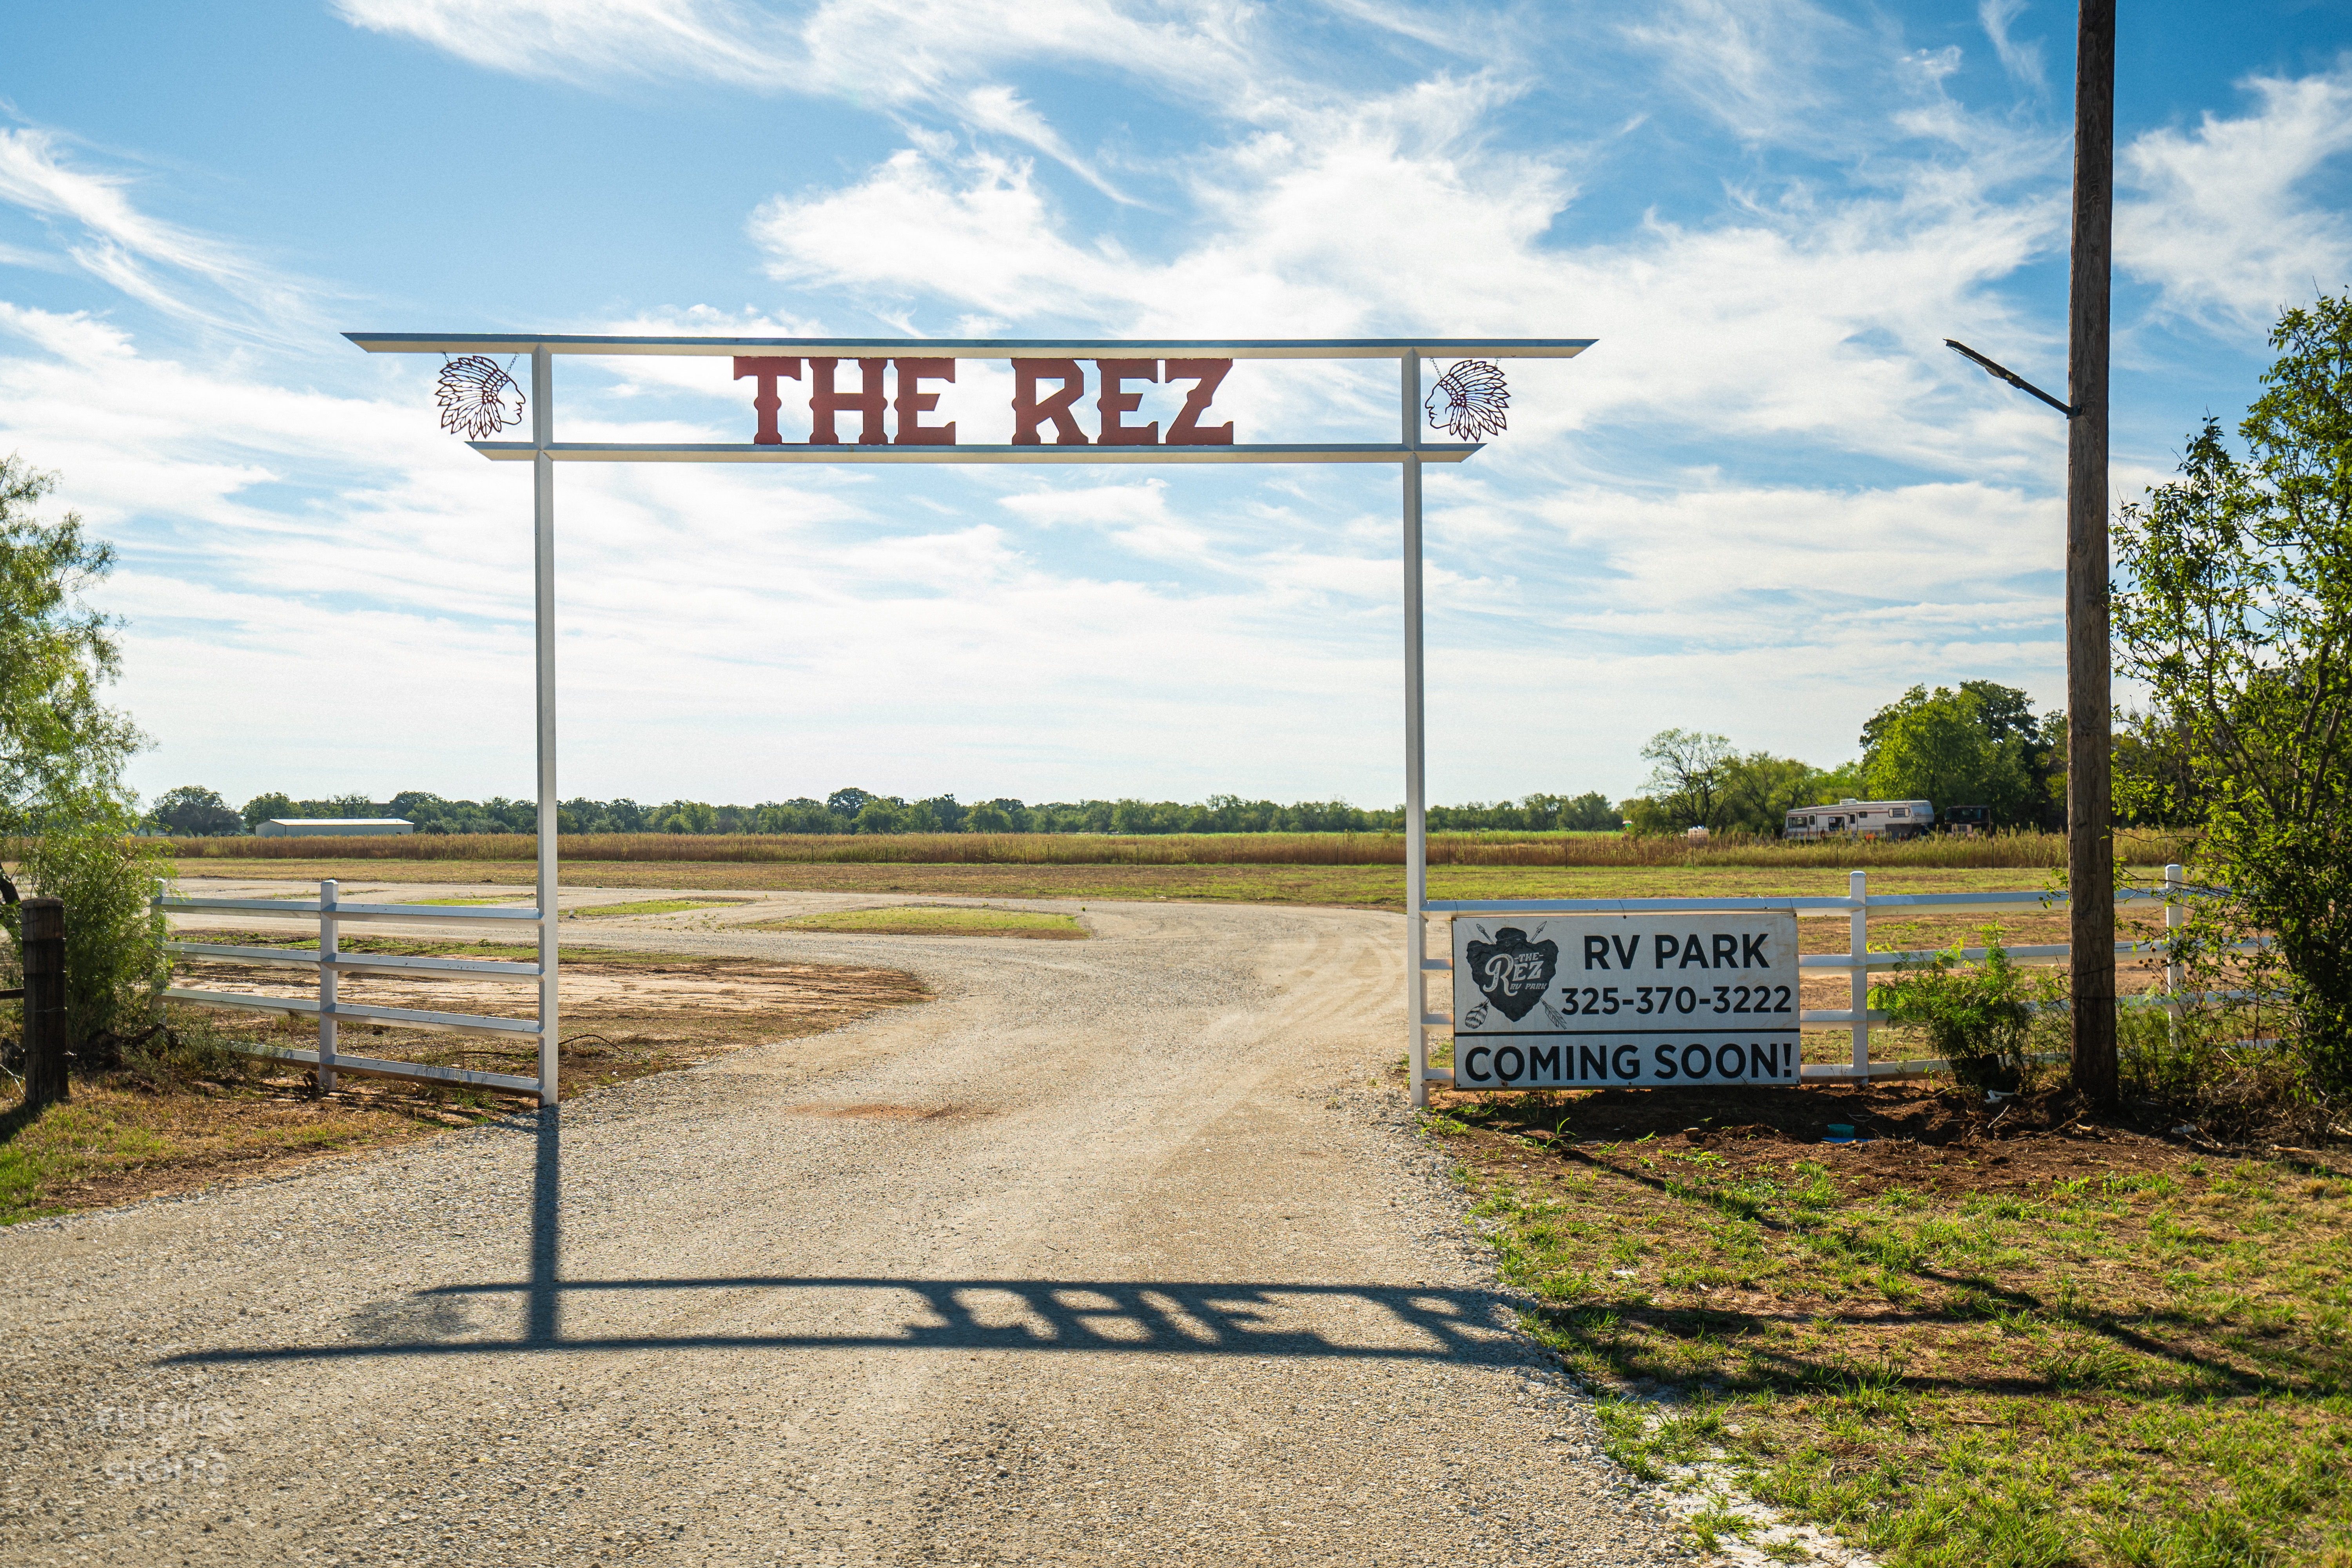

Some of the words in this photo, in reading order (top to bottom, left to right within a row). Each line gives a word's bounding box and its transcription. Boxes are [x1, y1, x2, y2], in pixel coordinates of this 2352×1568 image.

[733, 357, 956, 446] THE
[1011, 358, 1233, 446] REZ
[1584, 935, 1641, 970] RV
[1655, 933, 1770, 969] PARK
[1483, 953, 1544, 996] REZ
[1561, 985, 1791, 1016] 325-370-3222
[1465, 1044, 1641, 1082] COMING
[1653, 1043, 1792, 1080] SOON!
